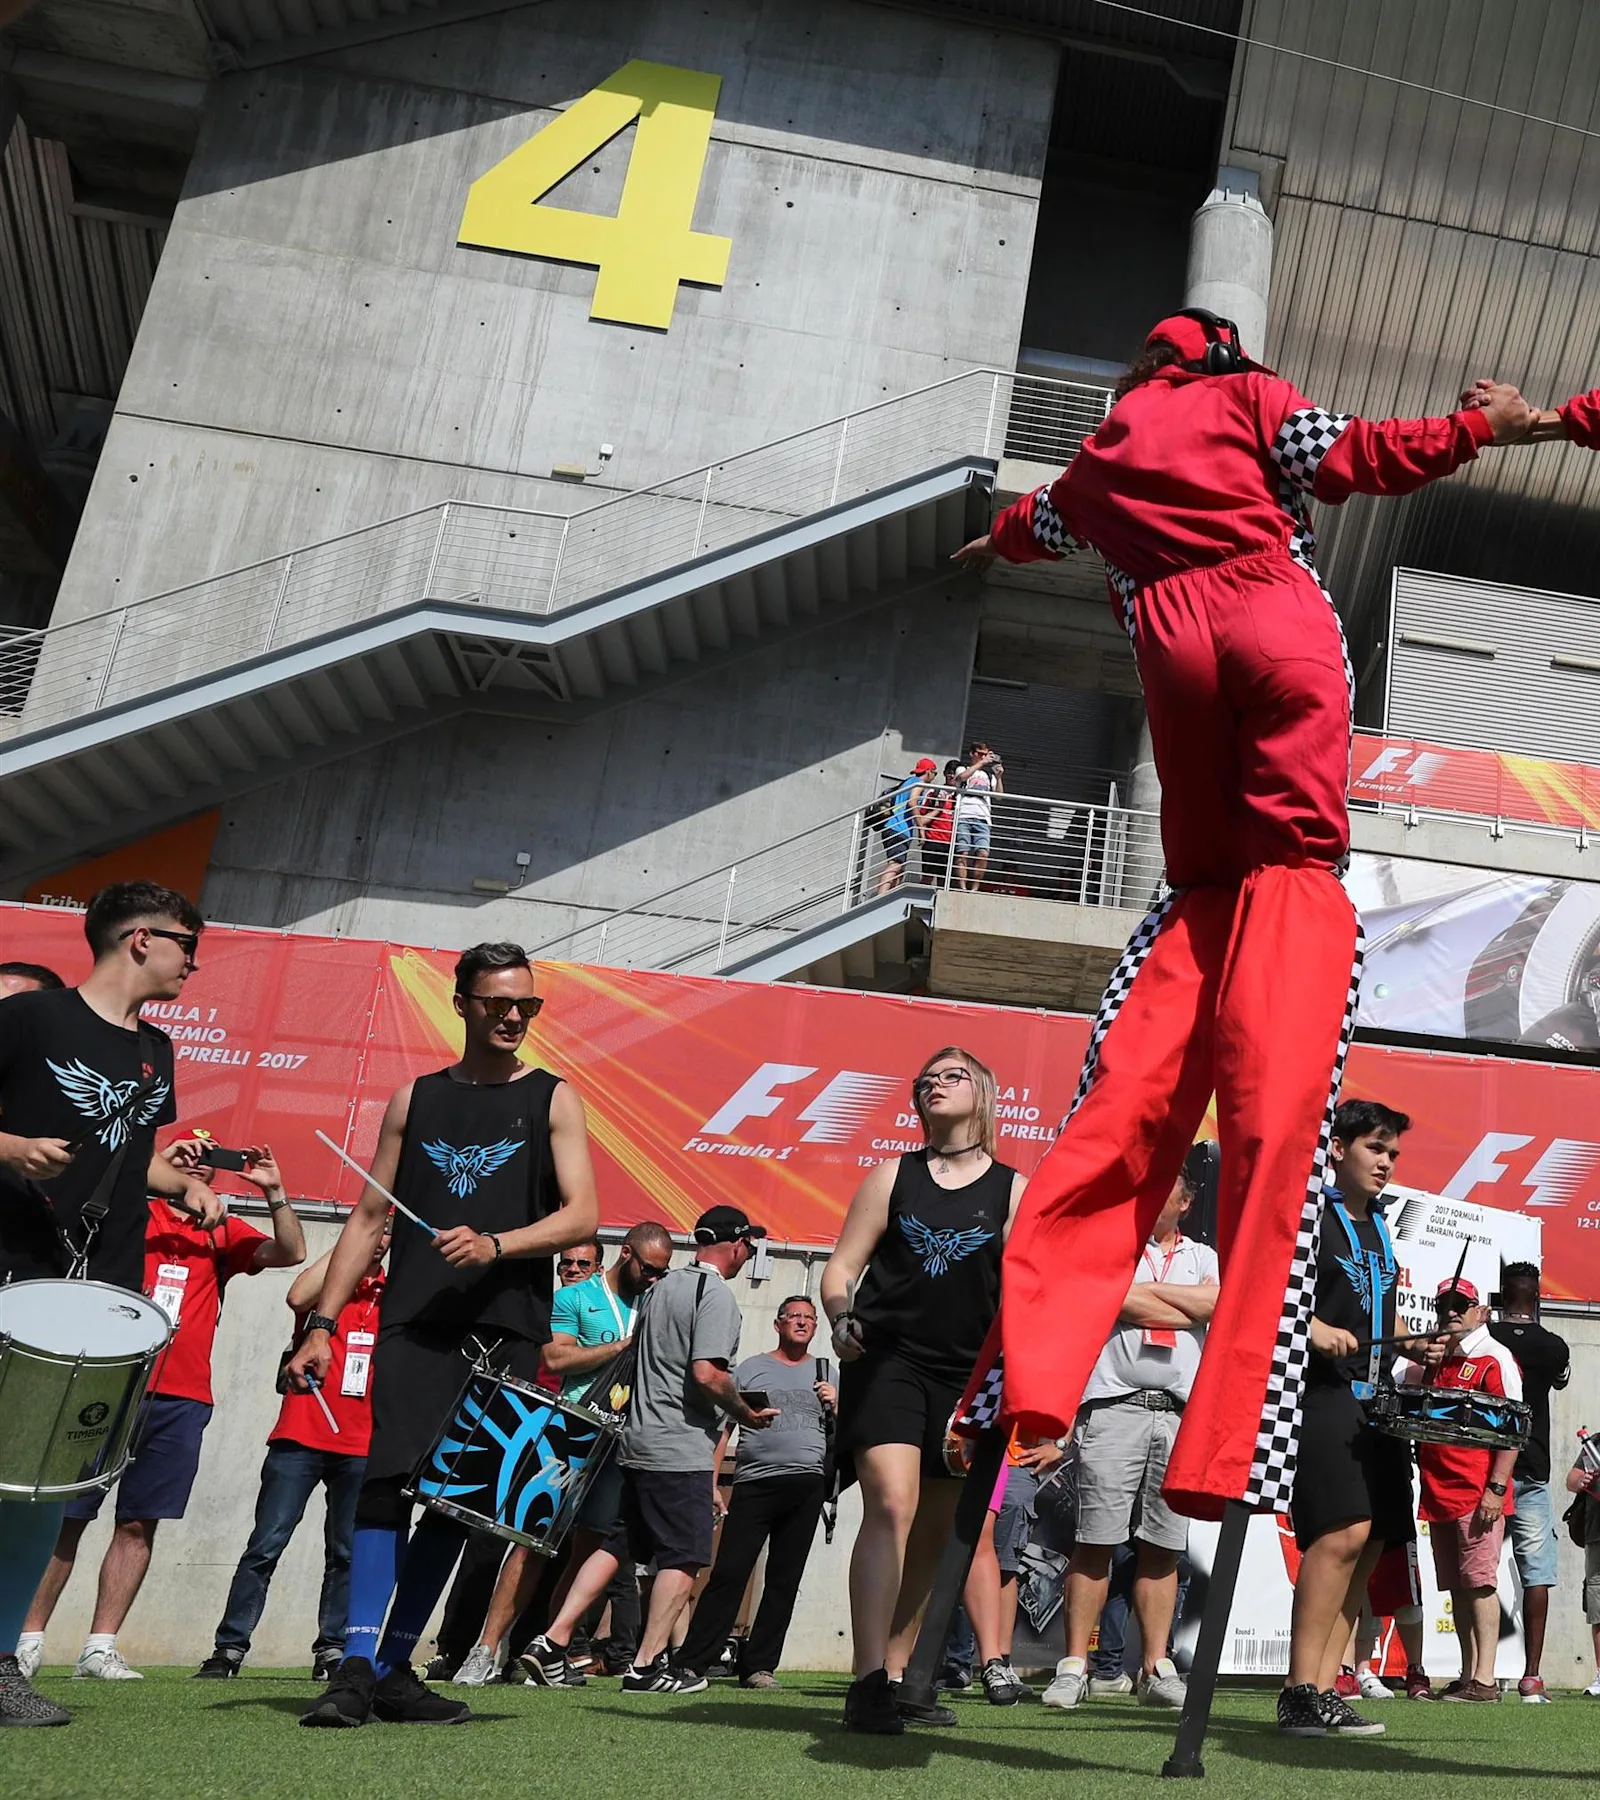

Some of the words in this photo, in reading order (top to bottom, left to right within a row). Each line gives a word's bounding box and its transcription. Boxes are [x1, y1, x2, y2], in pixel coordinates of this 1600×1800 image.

[456, 58, 733, 330] 4
[1353, 780, 1395, 791] Formula
[207, 1008, 218, 1022] 1
[176, 1045, 251, 1066] PIRELLI
[256, 1052, 309, 1070] 2017
[1022, 1088, 1030, 1102] 1
[698, 1061, 907, 1145] F1
[895, 1113, 919, 1128] DE
[682, 1136, 775, 1159] Formula
[776, 1145, 792, 1160] 1
[1430, 1215, 1445, 1225] GULF
[1446, 1220, 1457, 1228] AIR
[1435, 1206, 1450, 1215] 2017
[1451, 1209, 1480, 1222] FORMULA
[1425, 1224, 1454, 1238] BAHRAIN
